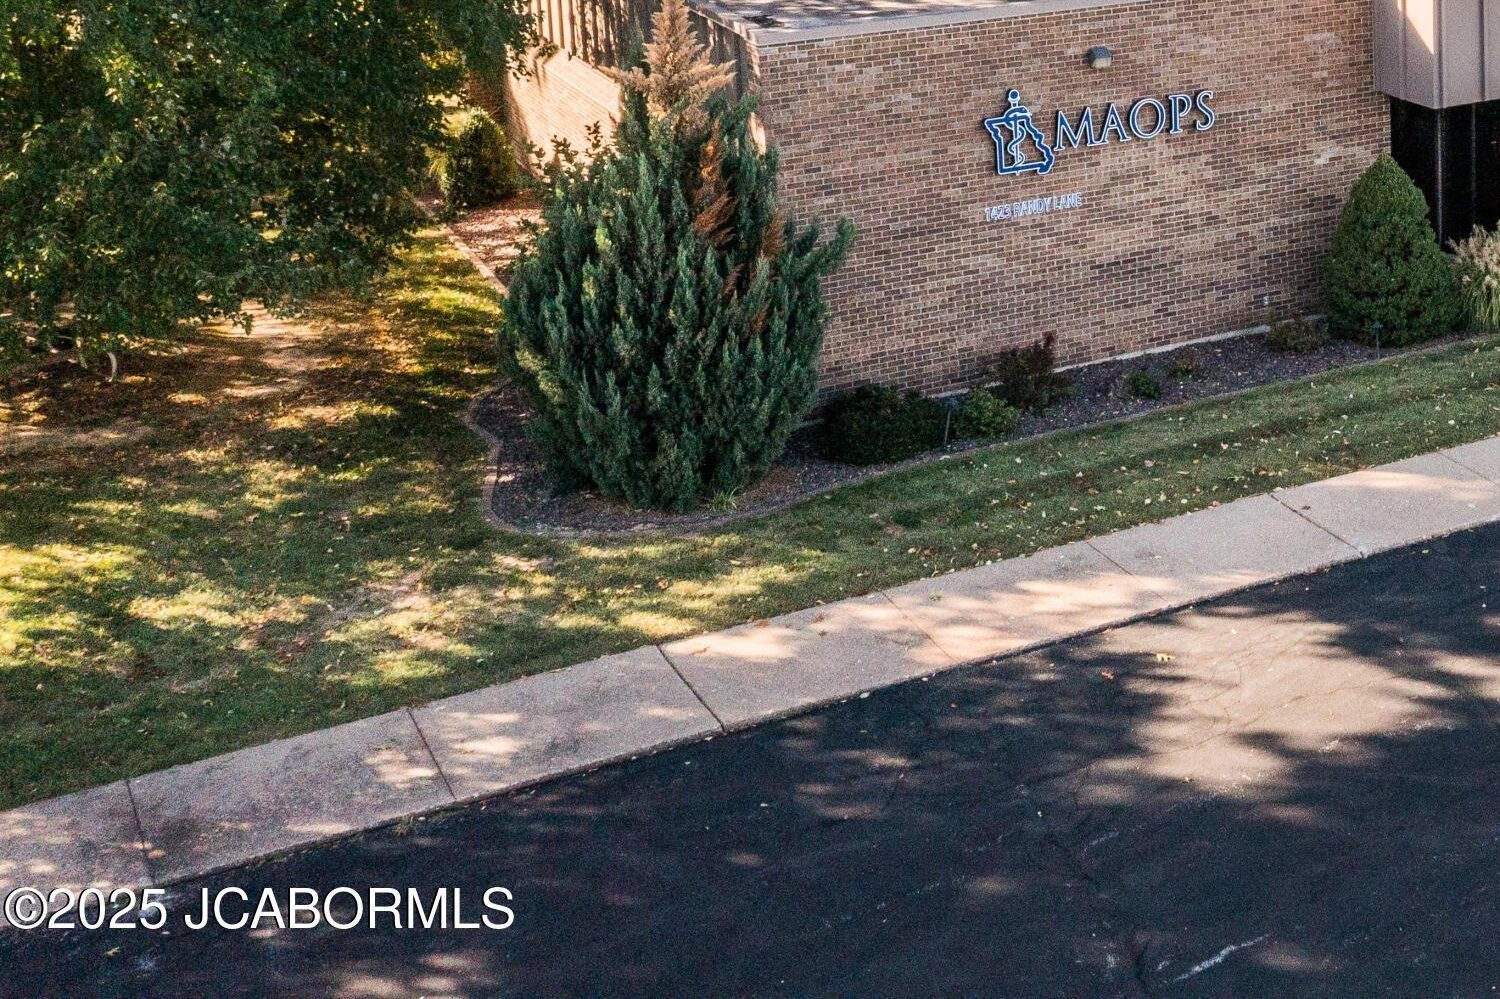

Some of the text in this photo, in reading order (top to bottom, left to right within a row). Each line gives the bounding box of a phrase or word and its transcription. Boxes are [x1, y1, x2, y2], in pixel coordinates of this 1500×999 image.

[1053, 90, 1215, 151] MAOPS
[985, 192, 1083, 222] 1423 RANDY LANE
